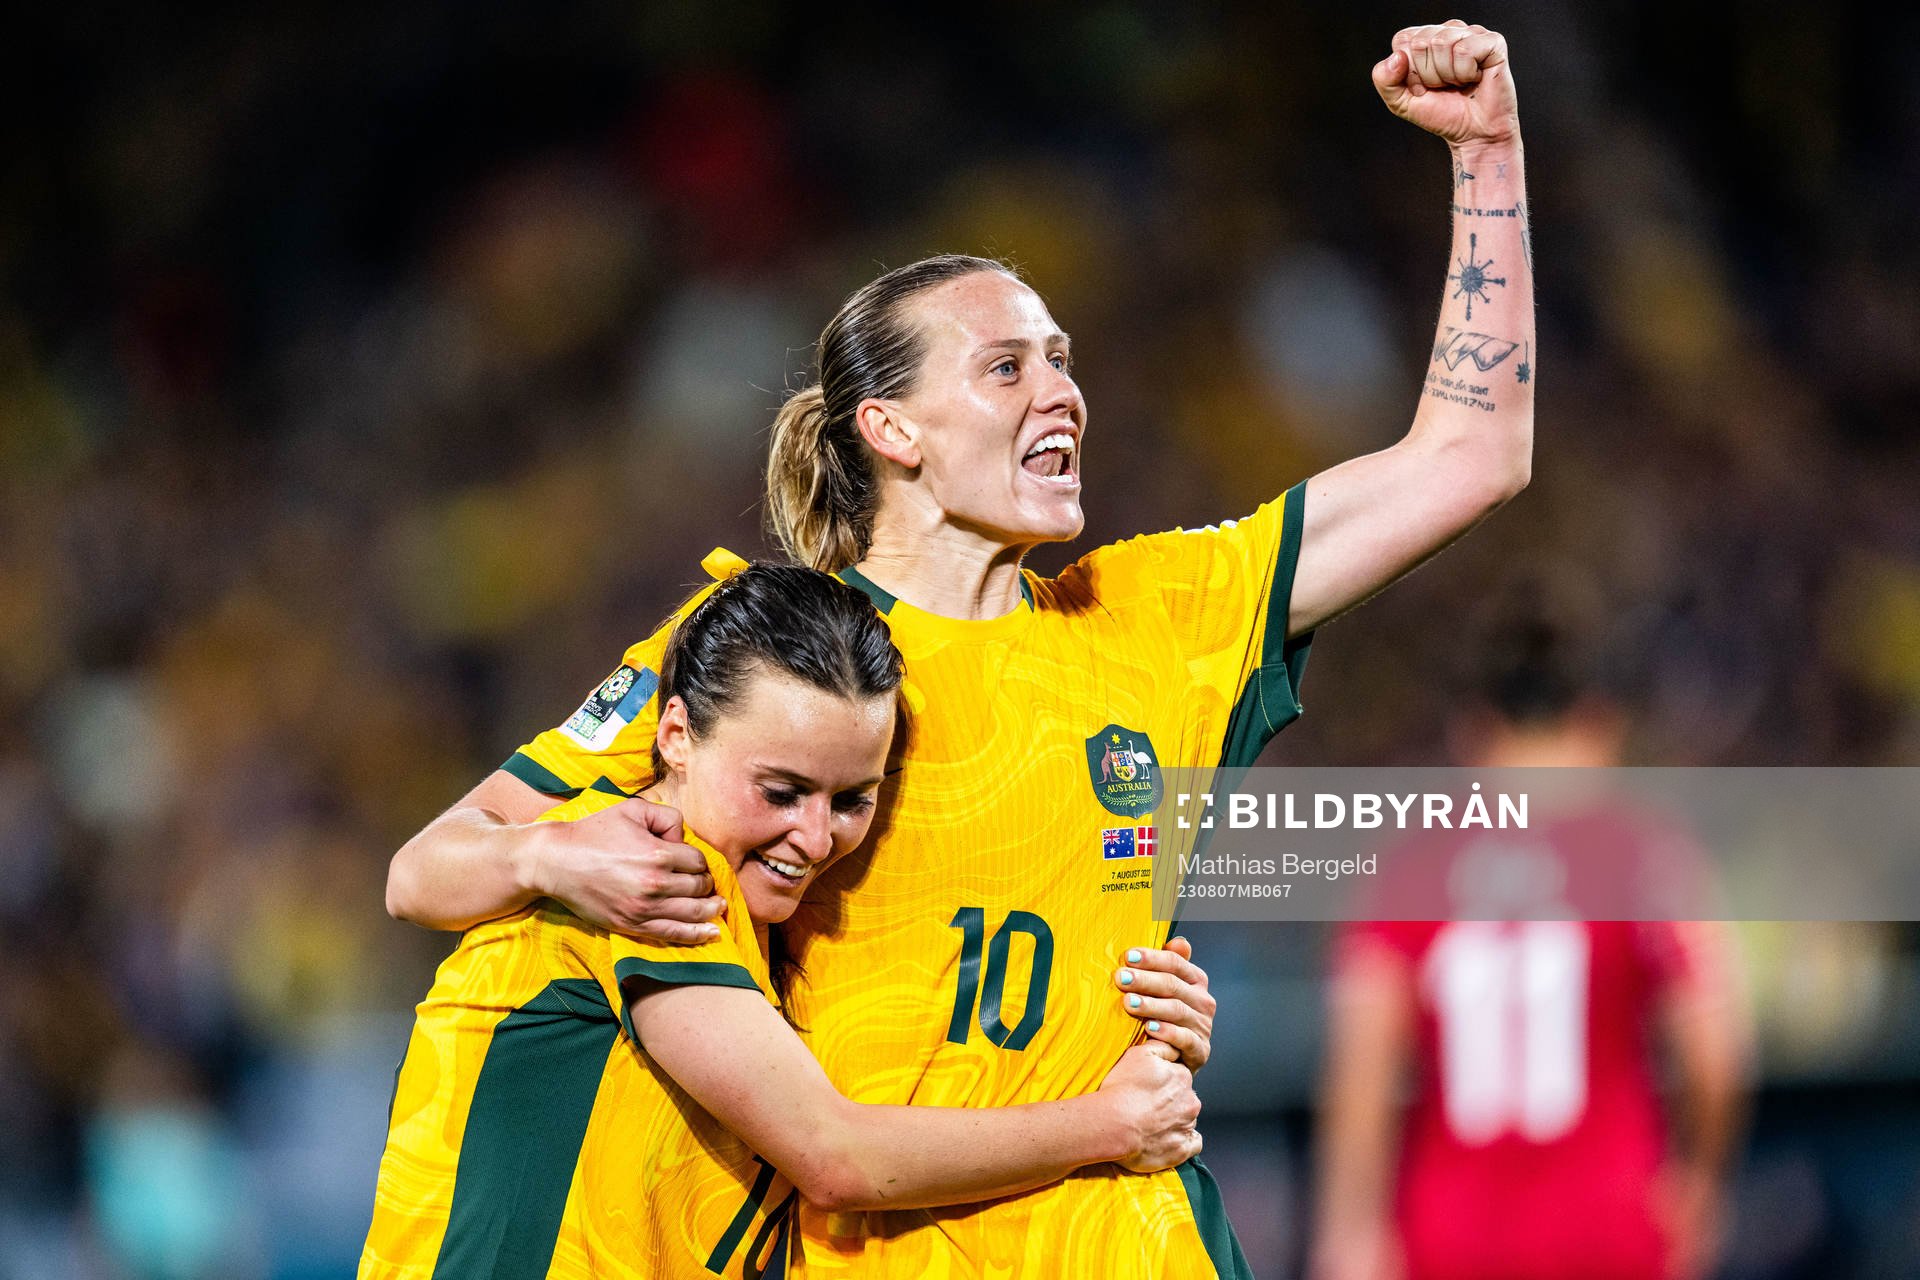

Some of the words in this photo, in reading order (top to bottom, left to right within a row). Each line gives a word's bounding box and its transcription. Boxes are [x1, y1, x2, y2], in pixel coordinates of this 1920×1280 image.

[1107, 781, 1152, 794] AUSTRALIA
[1117, 869, 1140, 879] AUGUST
[946, 906, 1055, 1051] 10
